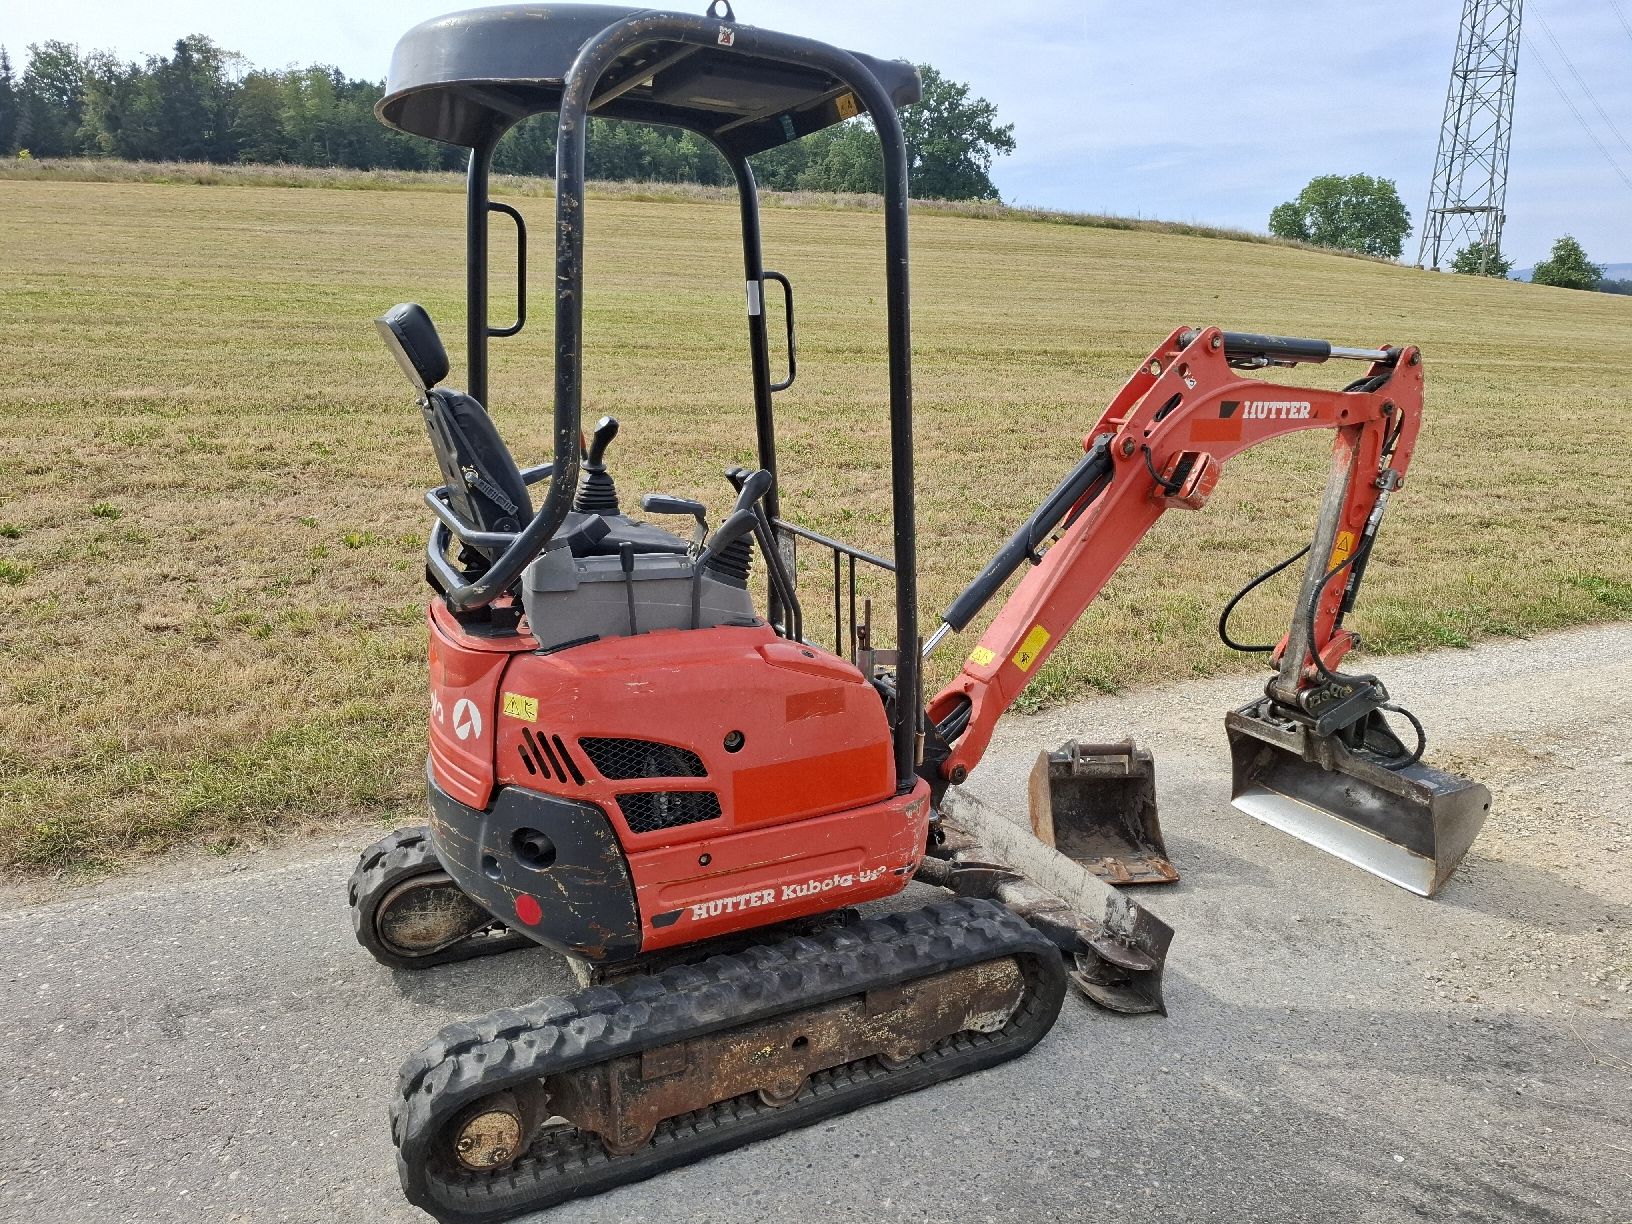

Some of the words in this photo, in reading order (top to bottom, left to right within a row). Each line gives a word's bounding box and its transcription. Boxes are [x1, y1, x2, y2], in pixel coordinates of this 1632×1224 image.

[1243, 401, 1311, 419] HUTTER
[691, 889, 775, 921] HUTTER
[781, 873, 853, 900] Kubota
